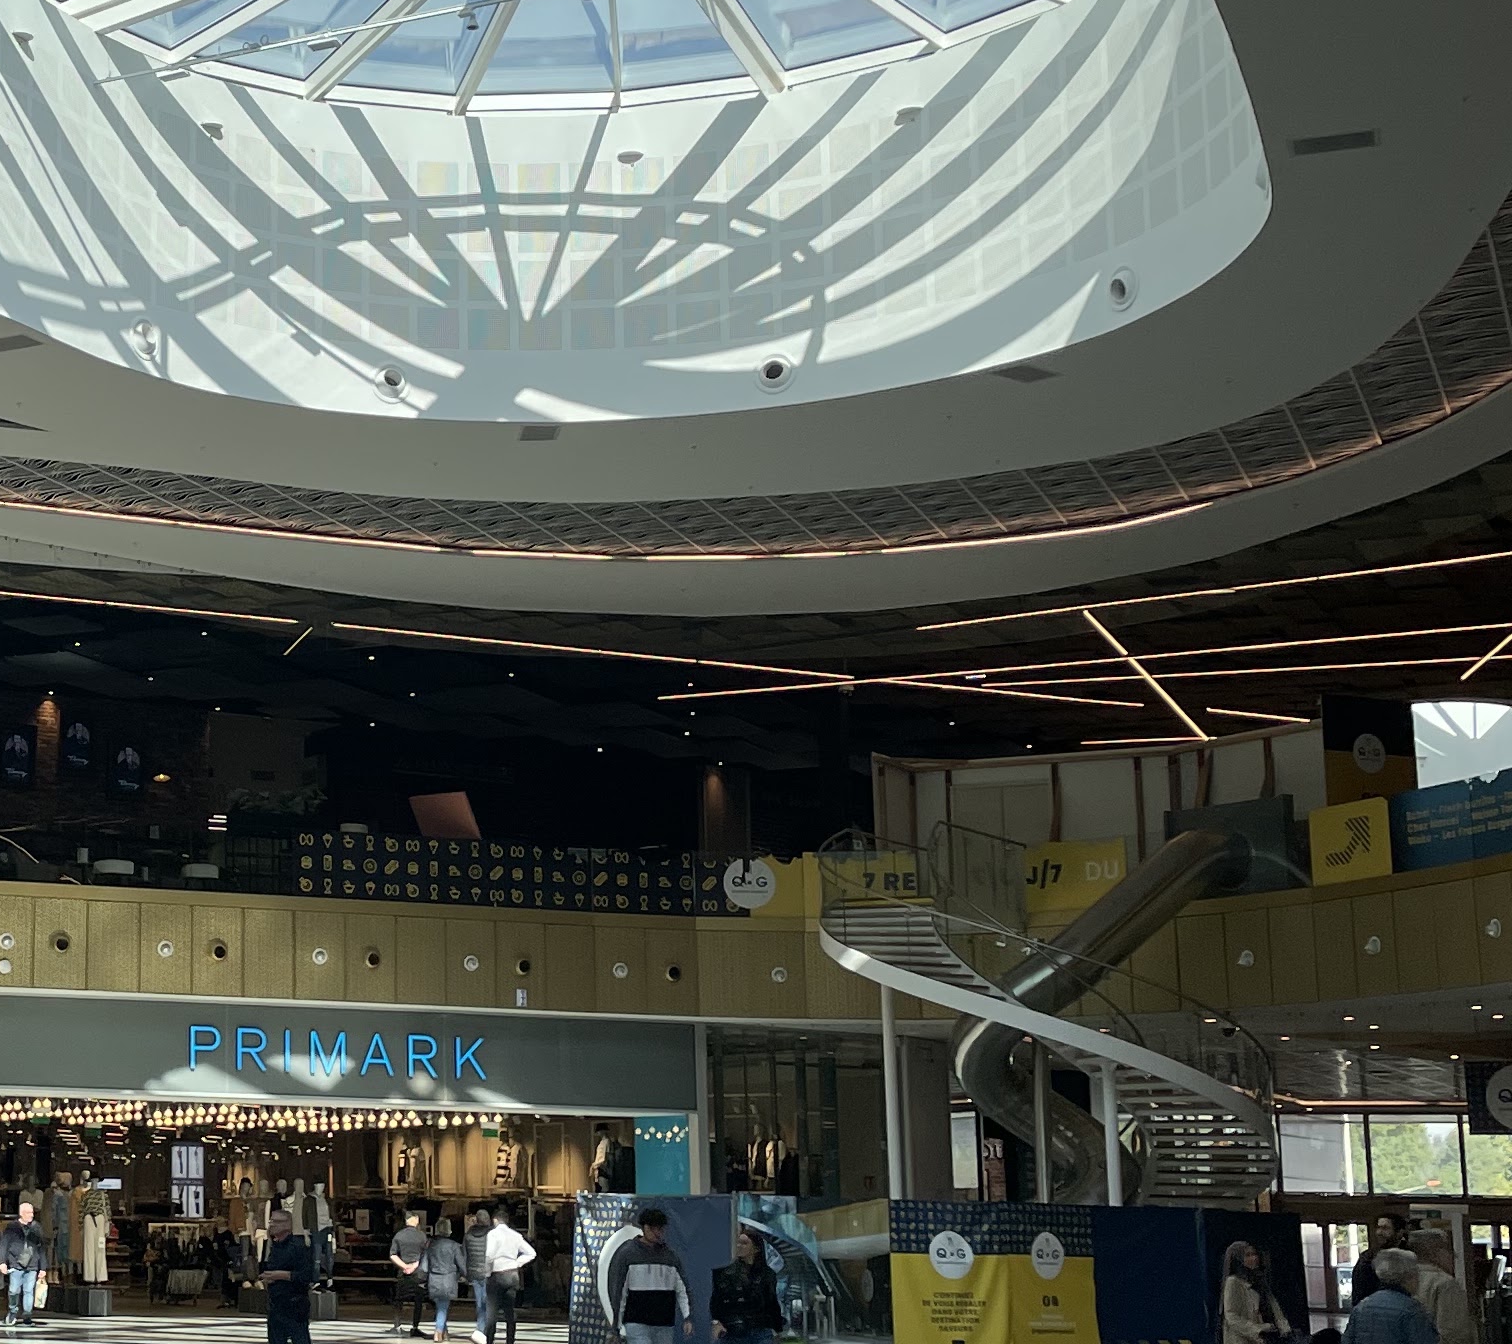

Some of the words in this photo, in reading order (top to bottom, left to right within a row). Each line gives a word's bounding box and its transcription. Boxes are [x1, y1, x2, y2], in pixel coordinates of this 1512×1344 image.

[1085, 861, 1120, 881] DU
[884, 872, 917, 891] RE
[188, 1024, 487, 1082] PRIMARK
